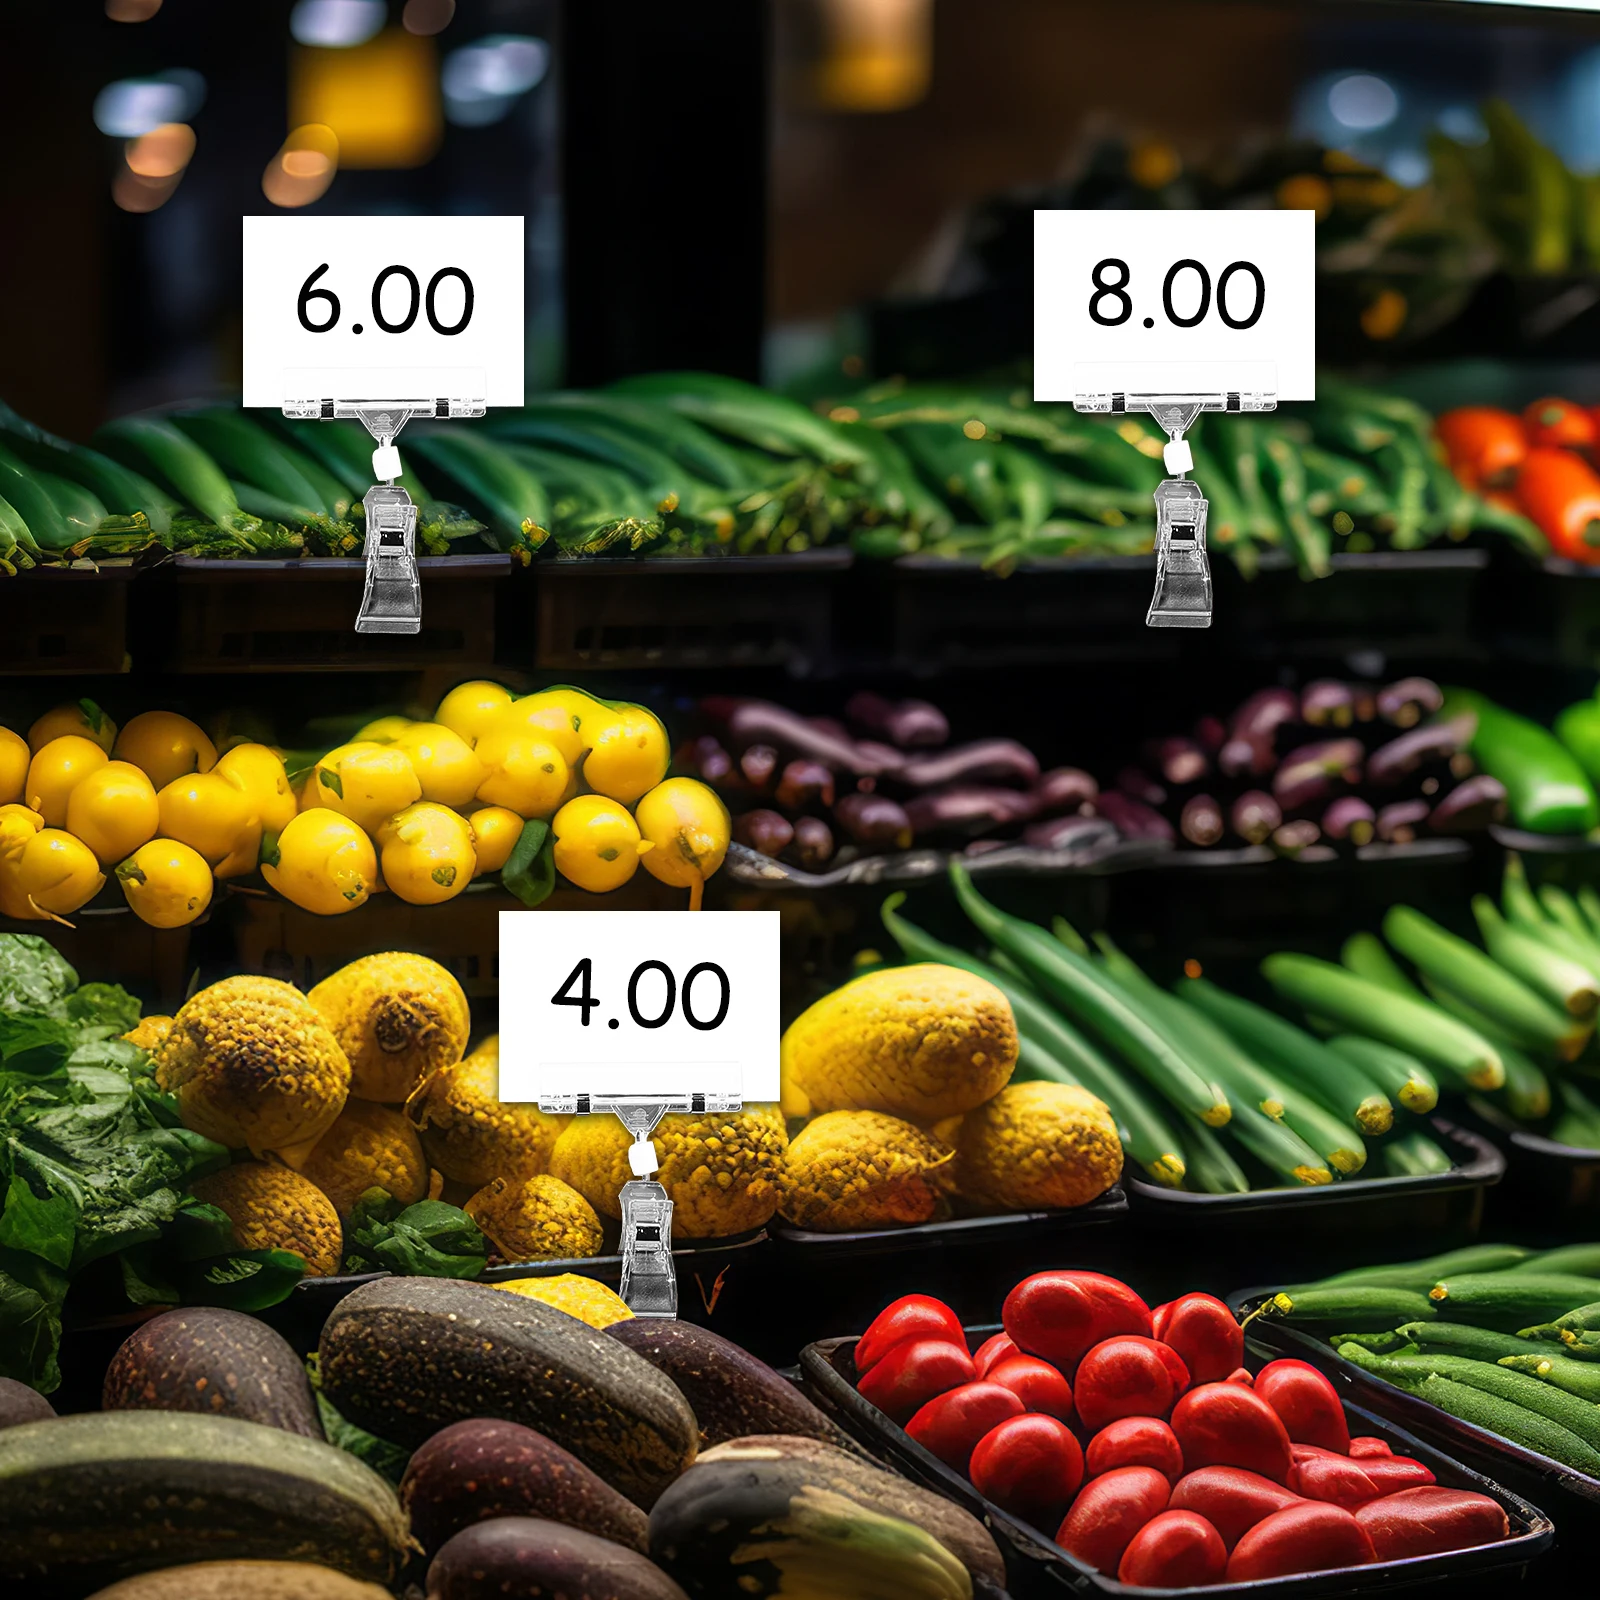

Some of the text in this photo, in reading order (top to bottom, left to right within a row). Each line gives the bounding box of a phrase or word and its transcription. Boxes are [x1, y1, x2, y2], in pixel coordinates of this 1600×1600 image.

[297, 262, 475, 336] 6.00
[1088, 257, 1266, 330] 8.00
[550, 957, 731, 1031] 4.00
